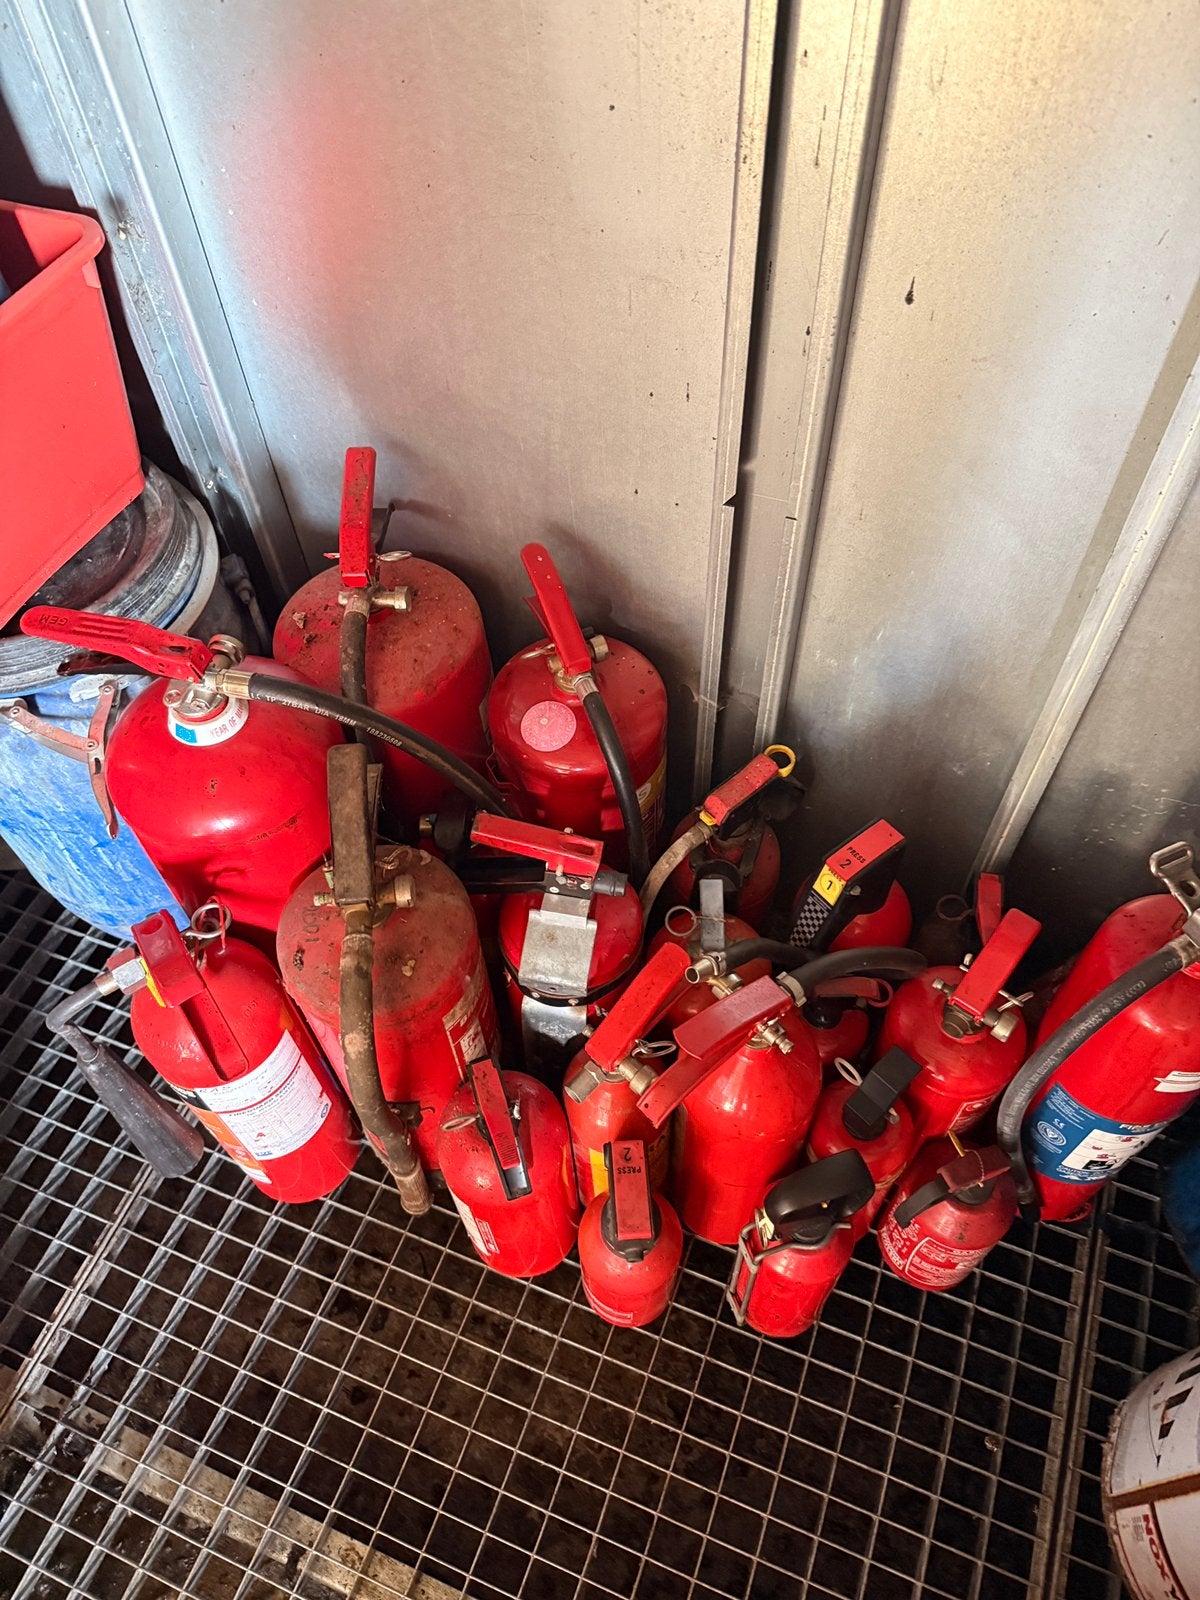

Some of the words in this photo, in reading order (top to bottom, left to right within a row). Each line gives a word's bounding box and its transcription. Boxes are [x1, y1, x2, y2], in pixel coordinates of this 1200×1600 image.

[39, 614, 68, 627] GEM
[282, 698, 310, 711] 27BAR
[334, 714, 357, 726] 18MM
[209, 723, 230, 738] YEAR
[228, 716, 238, 729] OF
[846, 846, 866, 864] PRESS
[839, 858, 852, 870] 2
[827, 880, 833, 891] 1
[623, 1147, 632, 1162] 2
[617, 1166, 642, 1175] PRESS
